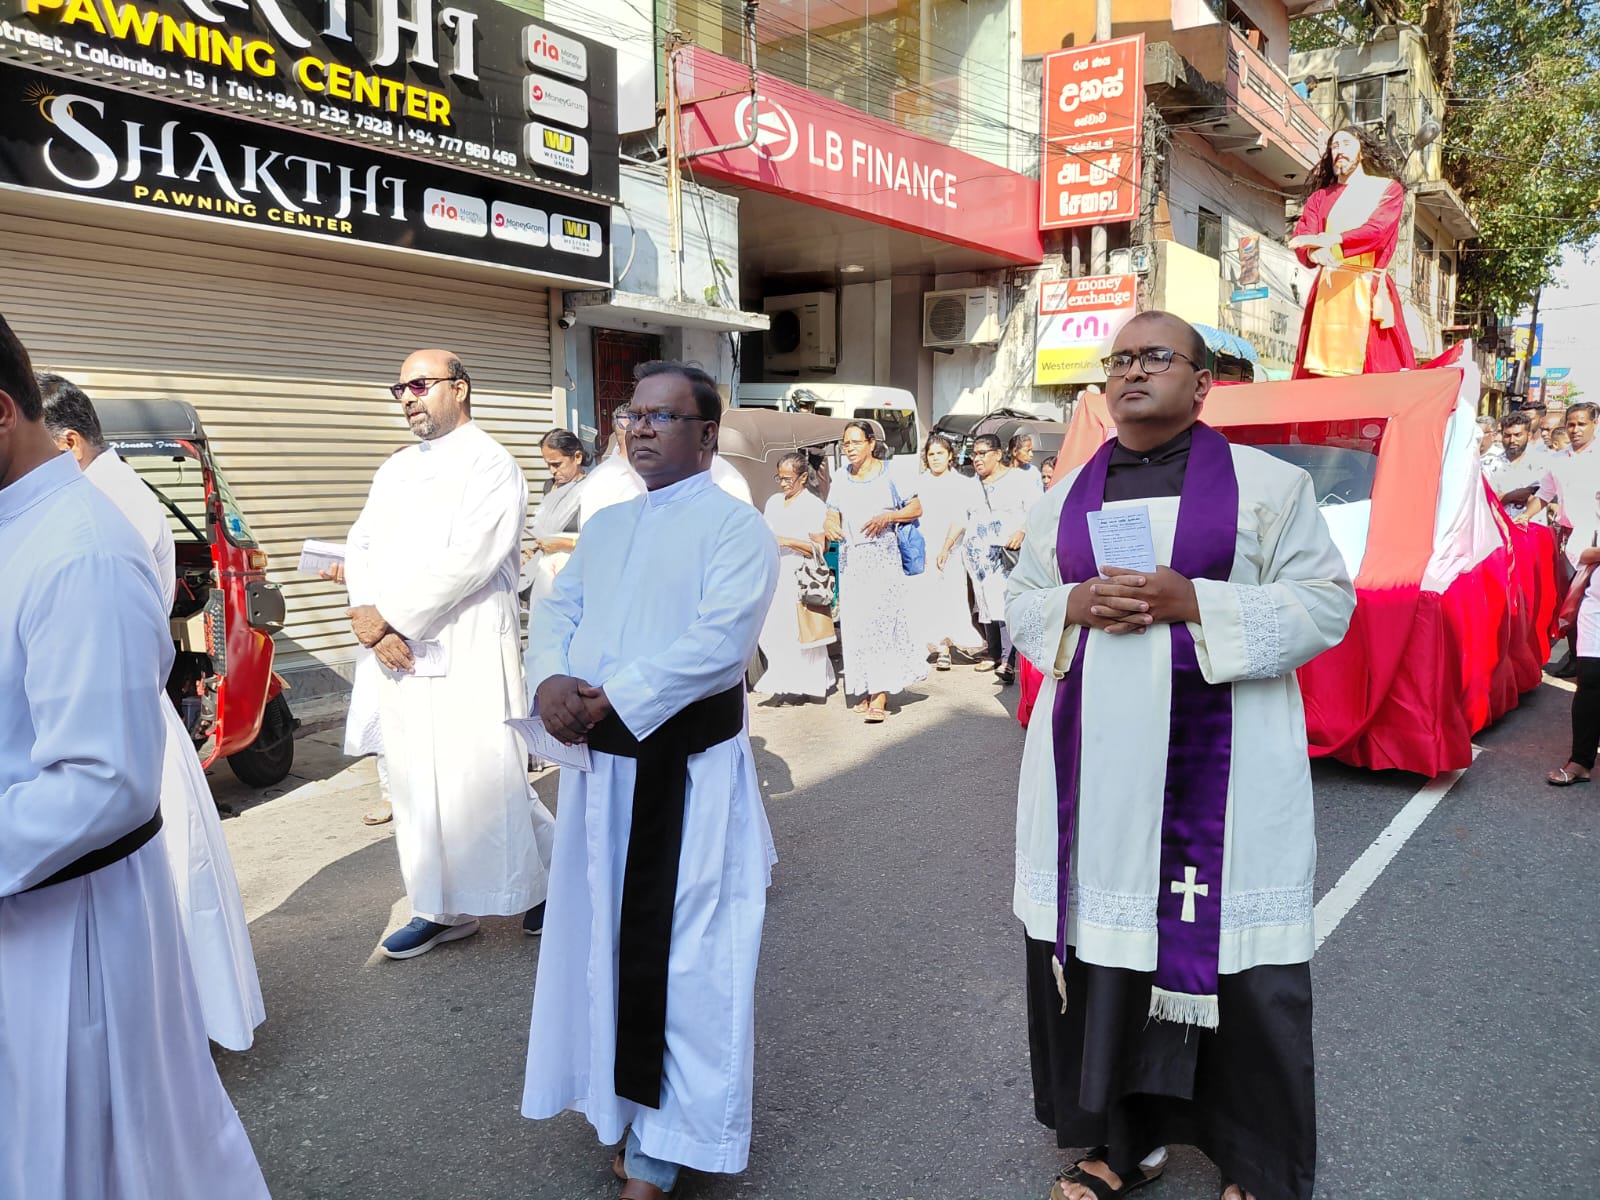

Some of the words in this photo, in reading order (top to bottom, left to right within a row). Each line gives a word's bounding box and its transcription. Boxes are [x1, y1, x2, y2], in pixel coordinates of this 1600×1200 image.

[533, 33, 559, 61] ria
[0, 20, 72, 58] treet,
[75, 42, 166, 79] Colombo
[184, 69, 206, 89] 13
[300, 99, 315, 117] 11
[319, 104, 350, 125] 232
[355, 113, 393, 136] 7928
[407, 128, 435, 147] +94
[438, 134, 463, 153] 777
[298, 56, 451, 126] CENTER
[1059, 67, 1124, 112] උකස්
[545, 91, 585, 112] MoneyGram
[43, 94, 408, 222] SHAKTHI
[543, 151, 575, 164] WESTERN
[553, 160, 575, 170] UNION
[808, 122, 843, 172] LB
[852, 140, 957, 209] FINANCE
[134, 184, 258, 217] PAWNING
[267, 208, 353, 234] CENTER
[431, 197, 458, 221] ria
[506, 217, 545, 233] MoneyGram
[1076, 278, 1122, 292] money
[1068, 291, 1130, 306] exchange
